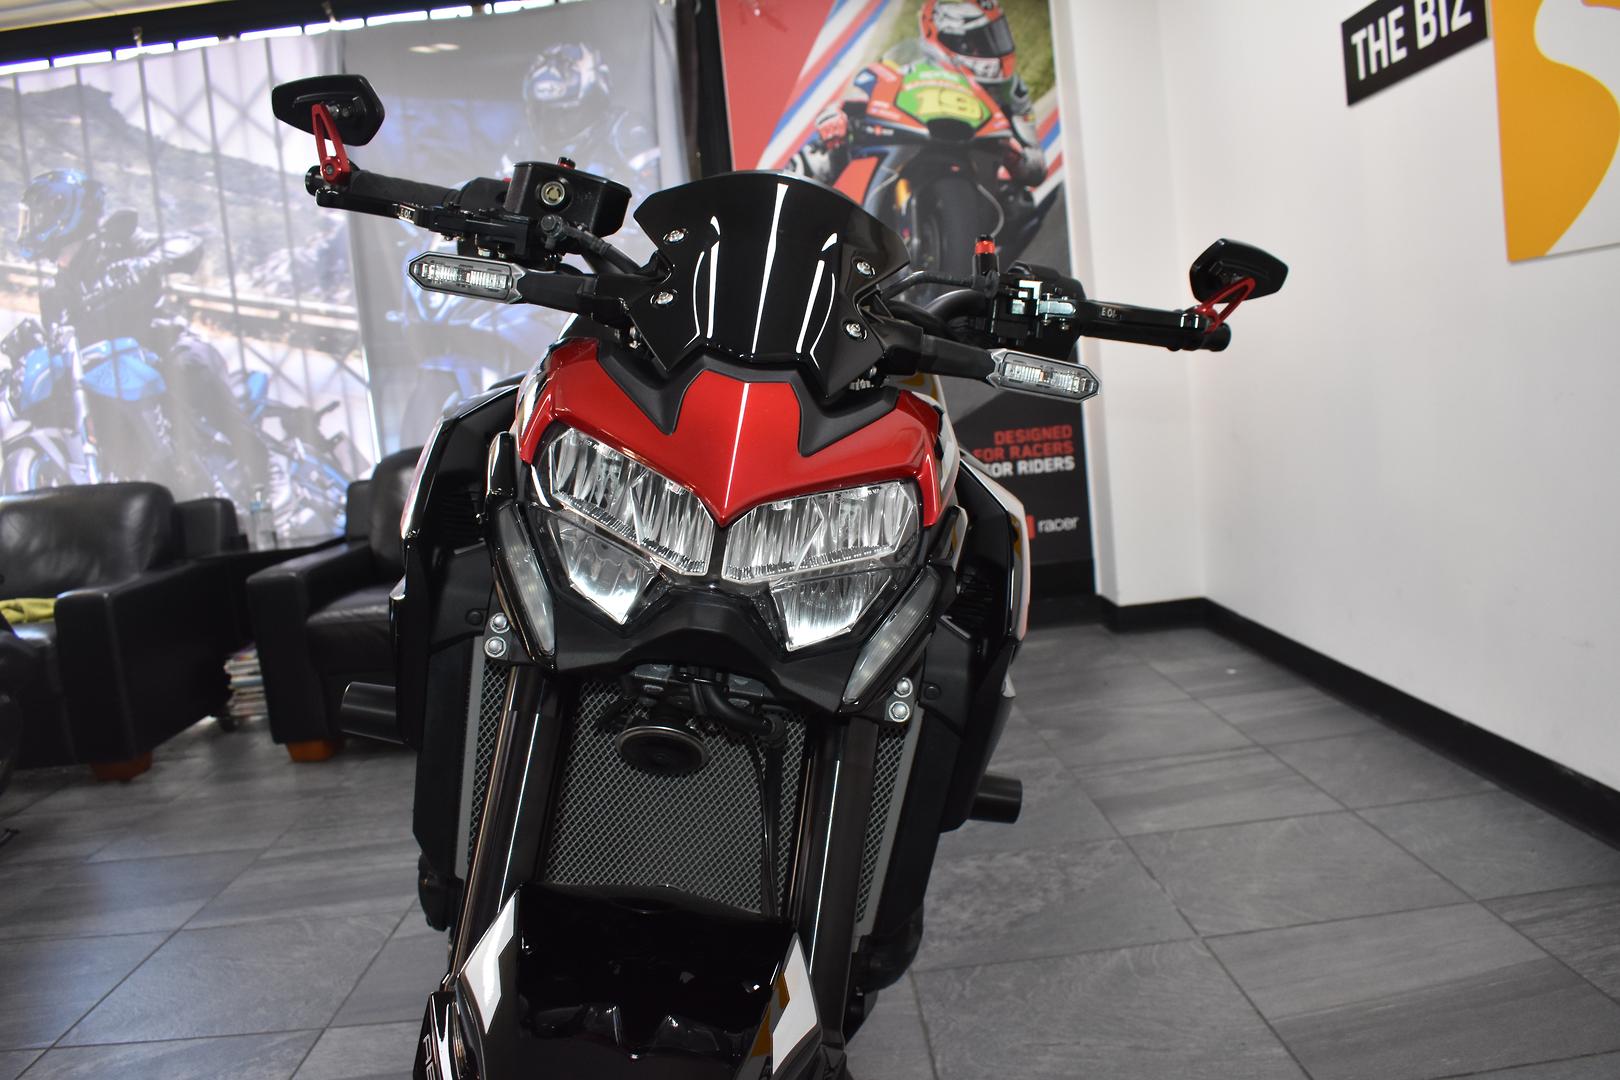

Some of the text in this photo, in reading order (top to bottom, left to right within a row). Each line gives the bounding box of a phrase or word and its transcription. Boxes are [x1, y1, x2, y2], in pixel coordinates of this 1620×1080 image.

[1351, 0, 1473, 81] THE BIZ
[994, 424, 1073, 446] DESIGNED
[1009, 441, 1074, 459] RACERS
[1016, 456, 1076, 475] RIDERS
[1037, 517, 1080, 533] racer
